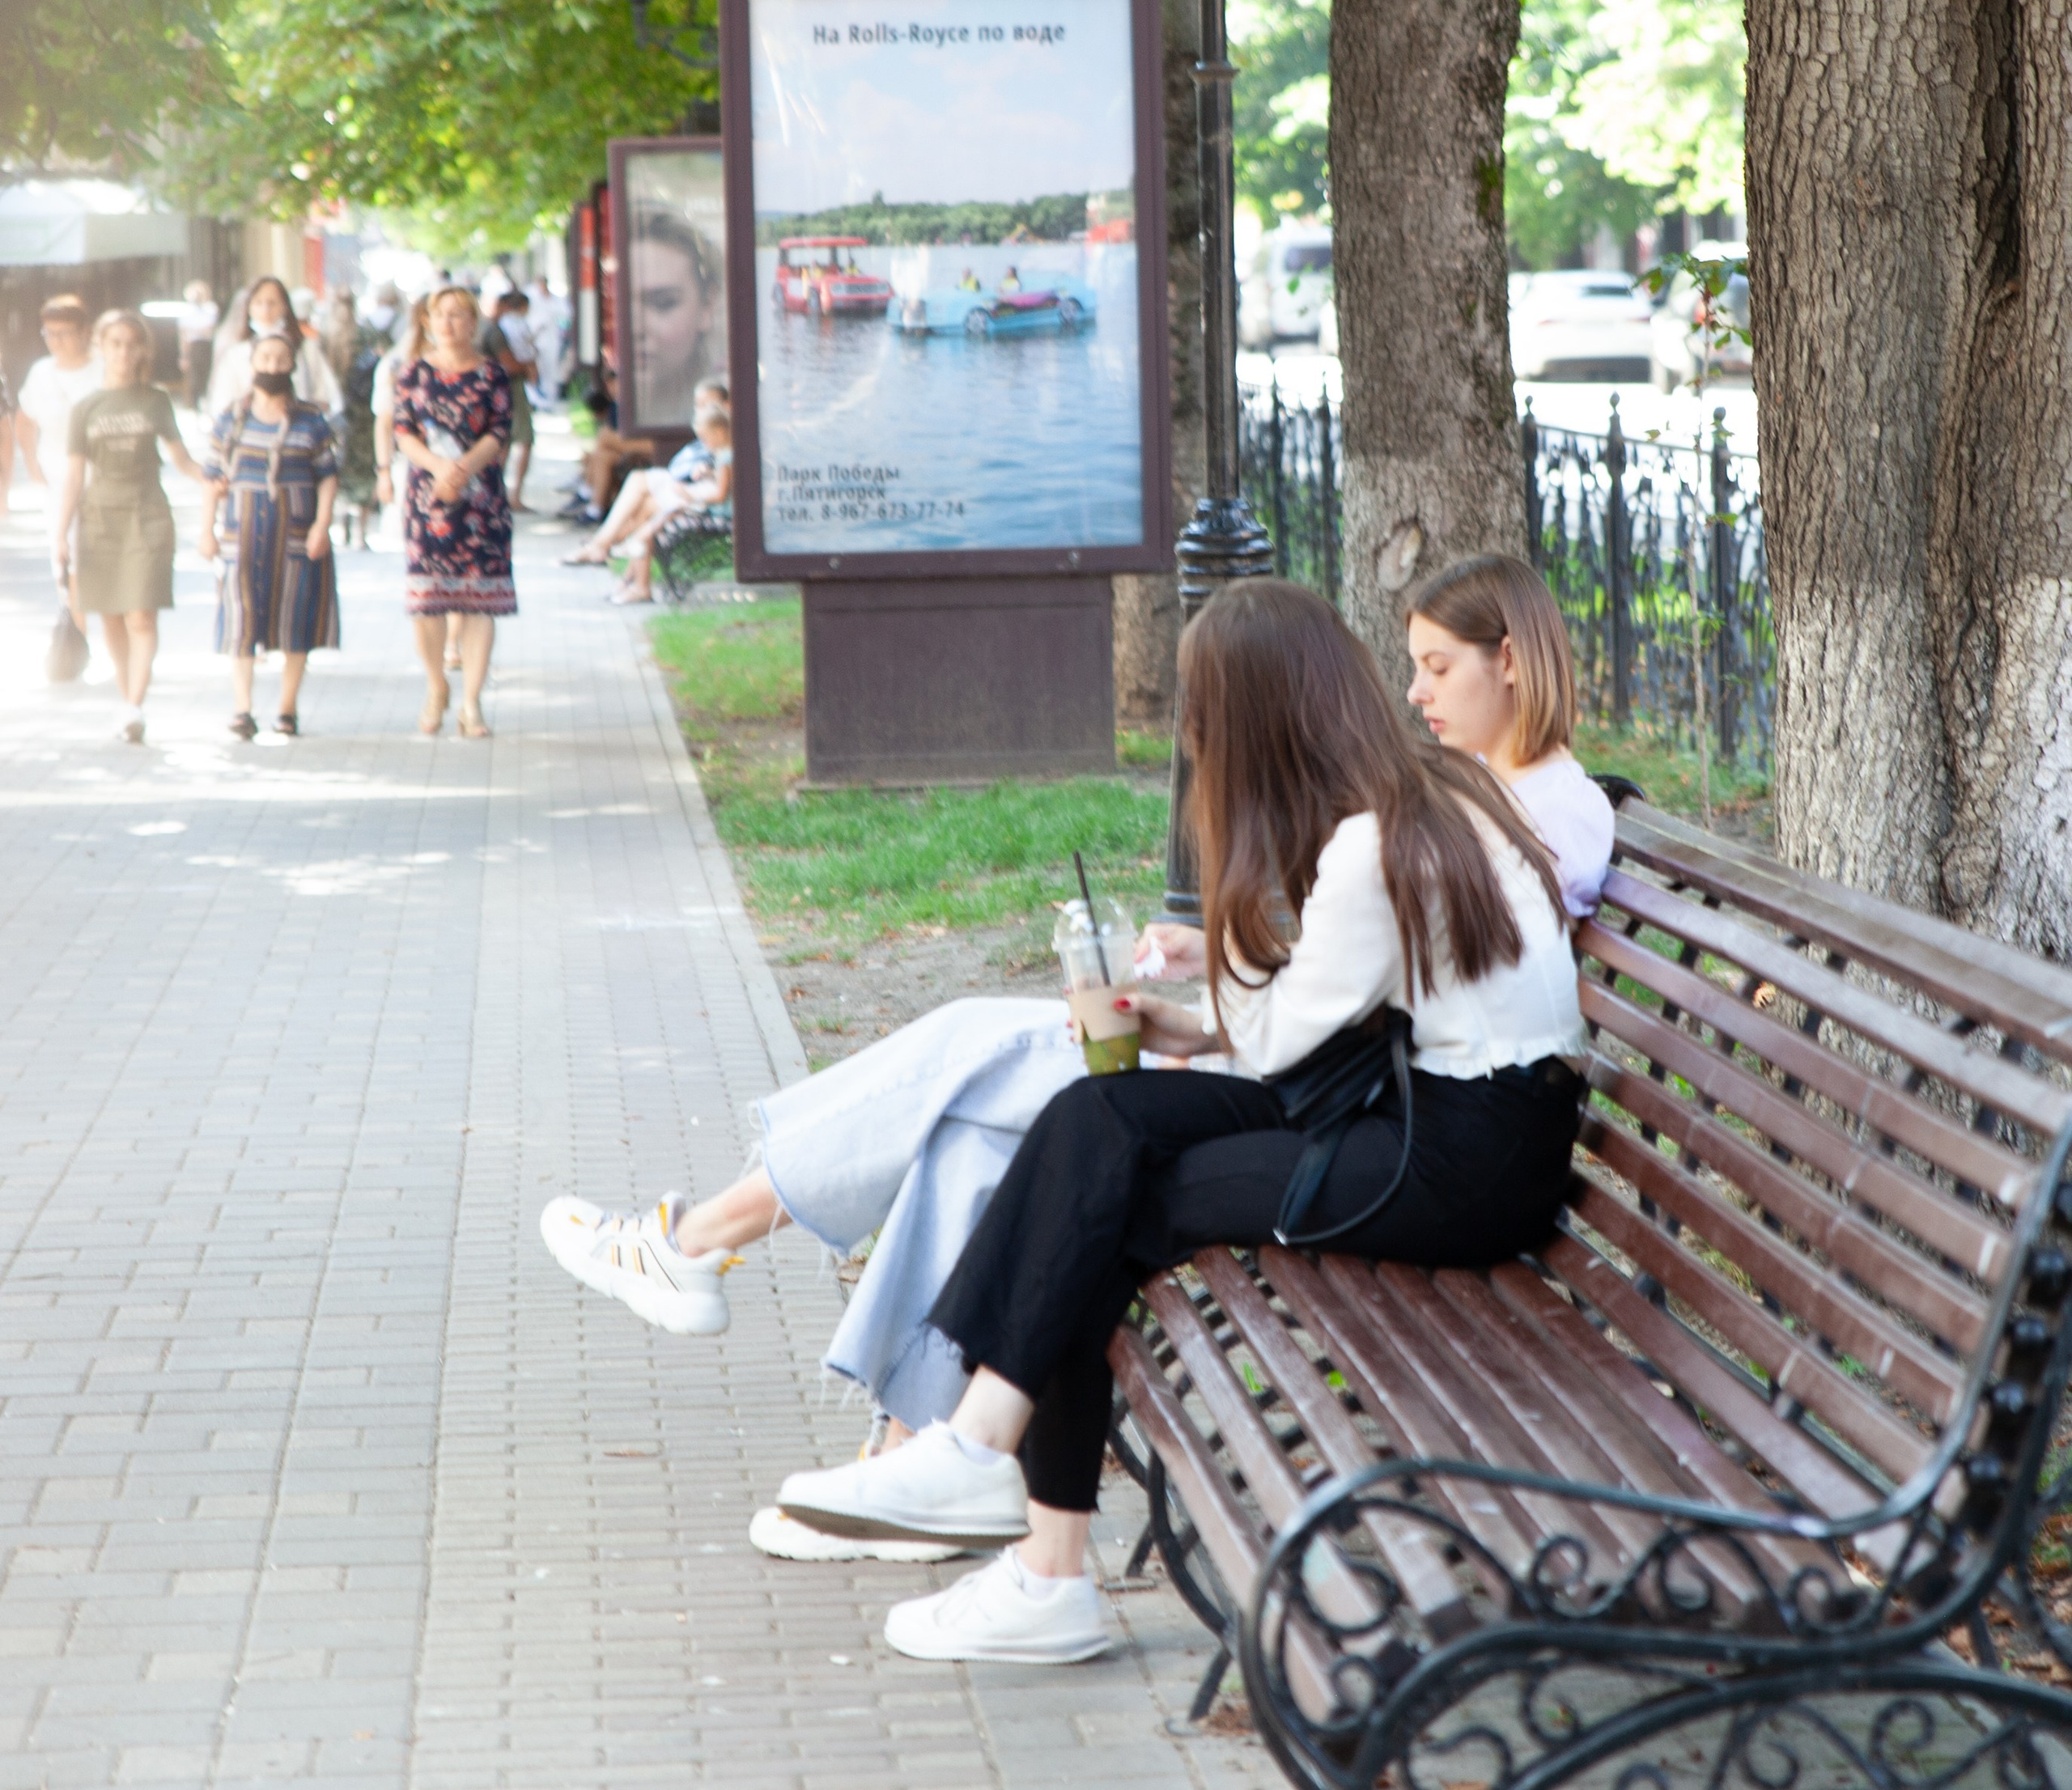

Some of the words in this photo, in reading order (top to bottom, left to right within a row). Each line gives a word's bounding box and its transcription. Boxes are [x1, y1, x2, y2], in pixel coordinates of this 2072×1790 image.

[813, 24, 839, 44] На
[849, 23, 970, 47] Rolls-Royce
[977, 24, 1004, 42] по
[1013, 23, 1065, 45] воде
[778, 464, 821, 486] Парк
[828, 463, 900, 483] Победы
[779, 506, 813, 522] тел.
